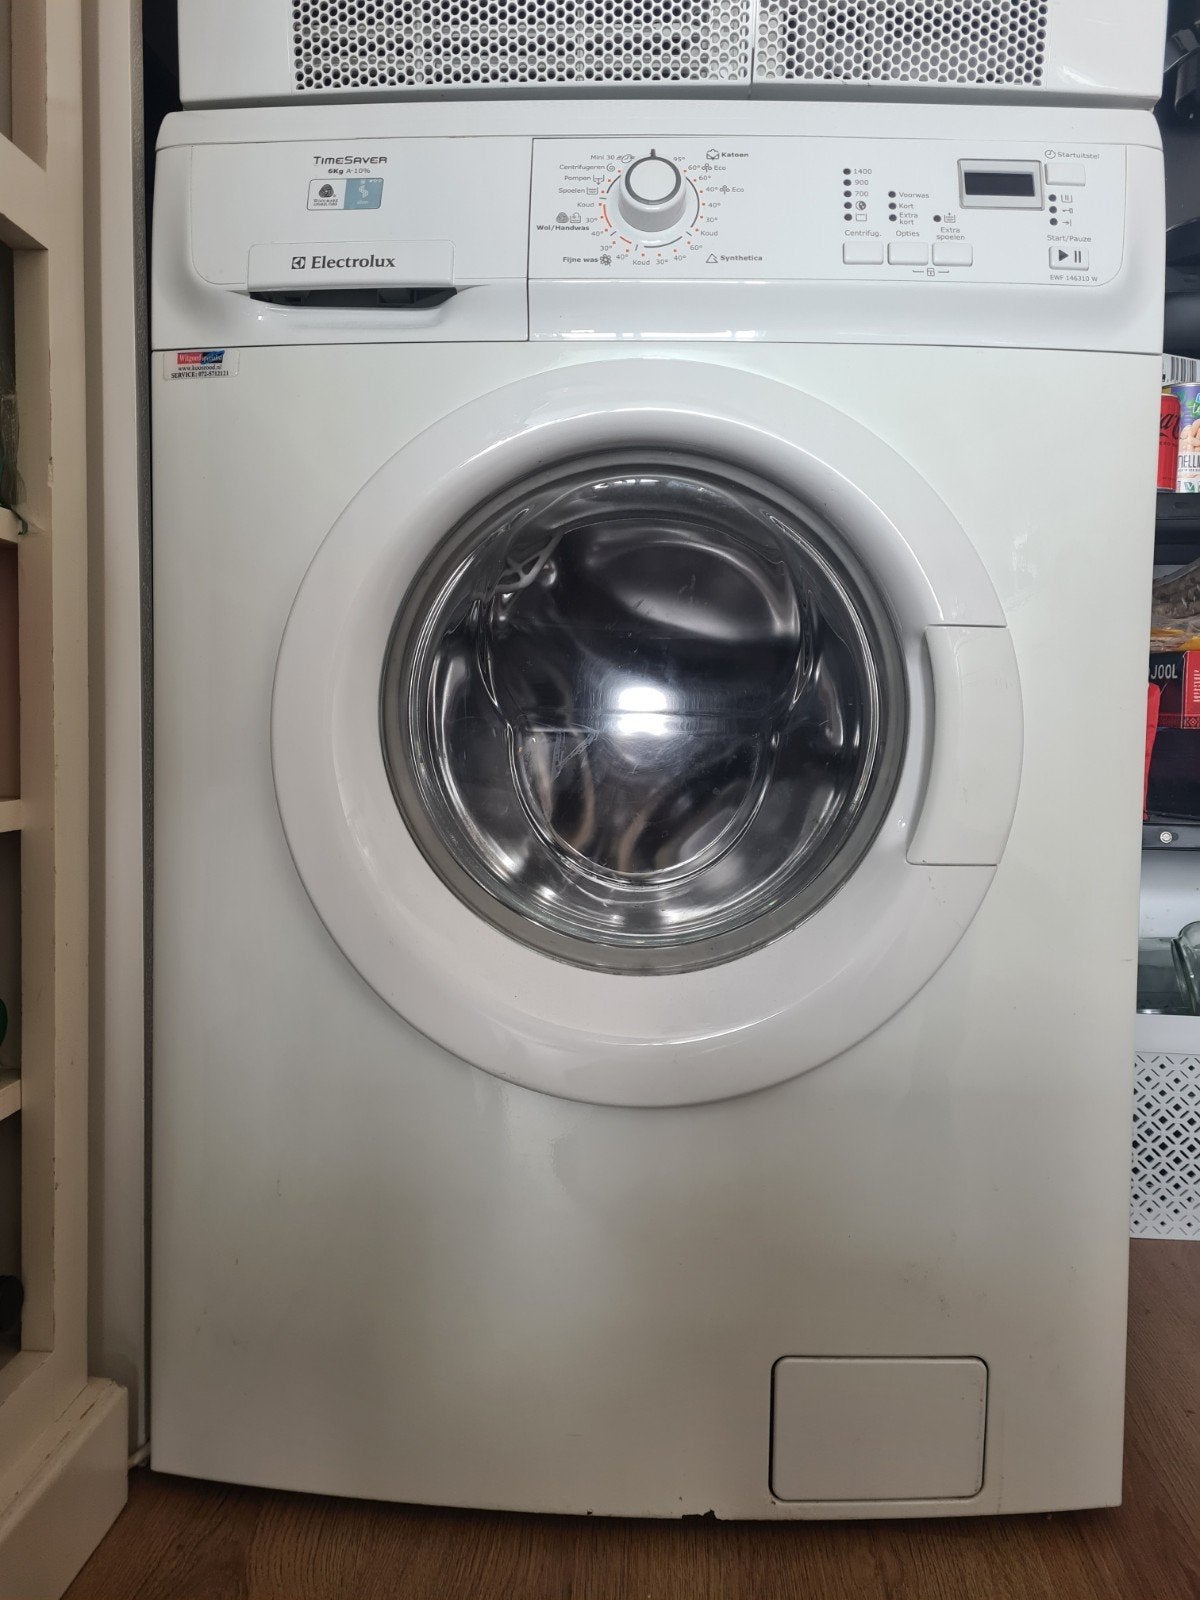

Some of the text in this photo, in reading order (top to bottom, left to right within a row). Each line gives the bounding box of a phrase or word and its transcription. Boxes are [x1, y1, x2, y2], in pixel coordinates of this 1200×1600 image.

[721, 151, 750, 159] Katoon
[1057, 150, 1100, 160] Startuitstel
[559, 164, 606, 172] Centrifugeren
[564, 175, 592, 183] Pompen
[558, 187, 586, 195] Spoelen
[898, 191, 930, 199] Voorwas
[844, 229, 882, 238] Centrifug.
[895, 229, 920, 238] Opties
[936, 233, 966, 241] spoelen
[311, 254, 396, 269] Electrolux
[562, 256, 581, 264] Fijne
[720, 254, 763, 262] Synthetica
[1149, 664, 1178, 680] JOOL
